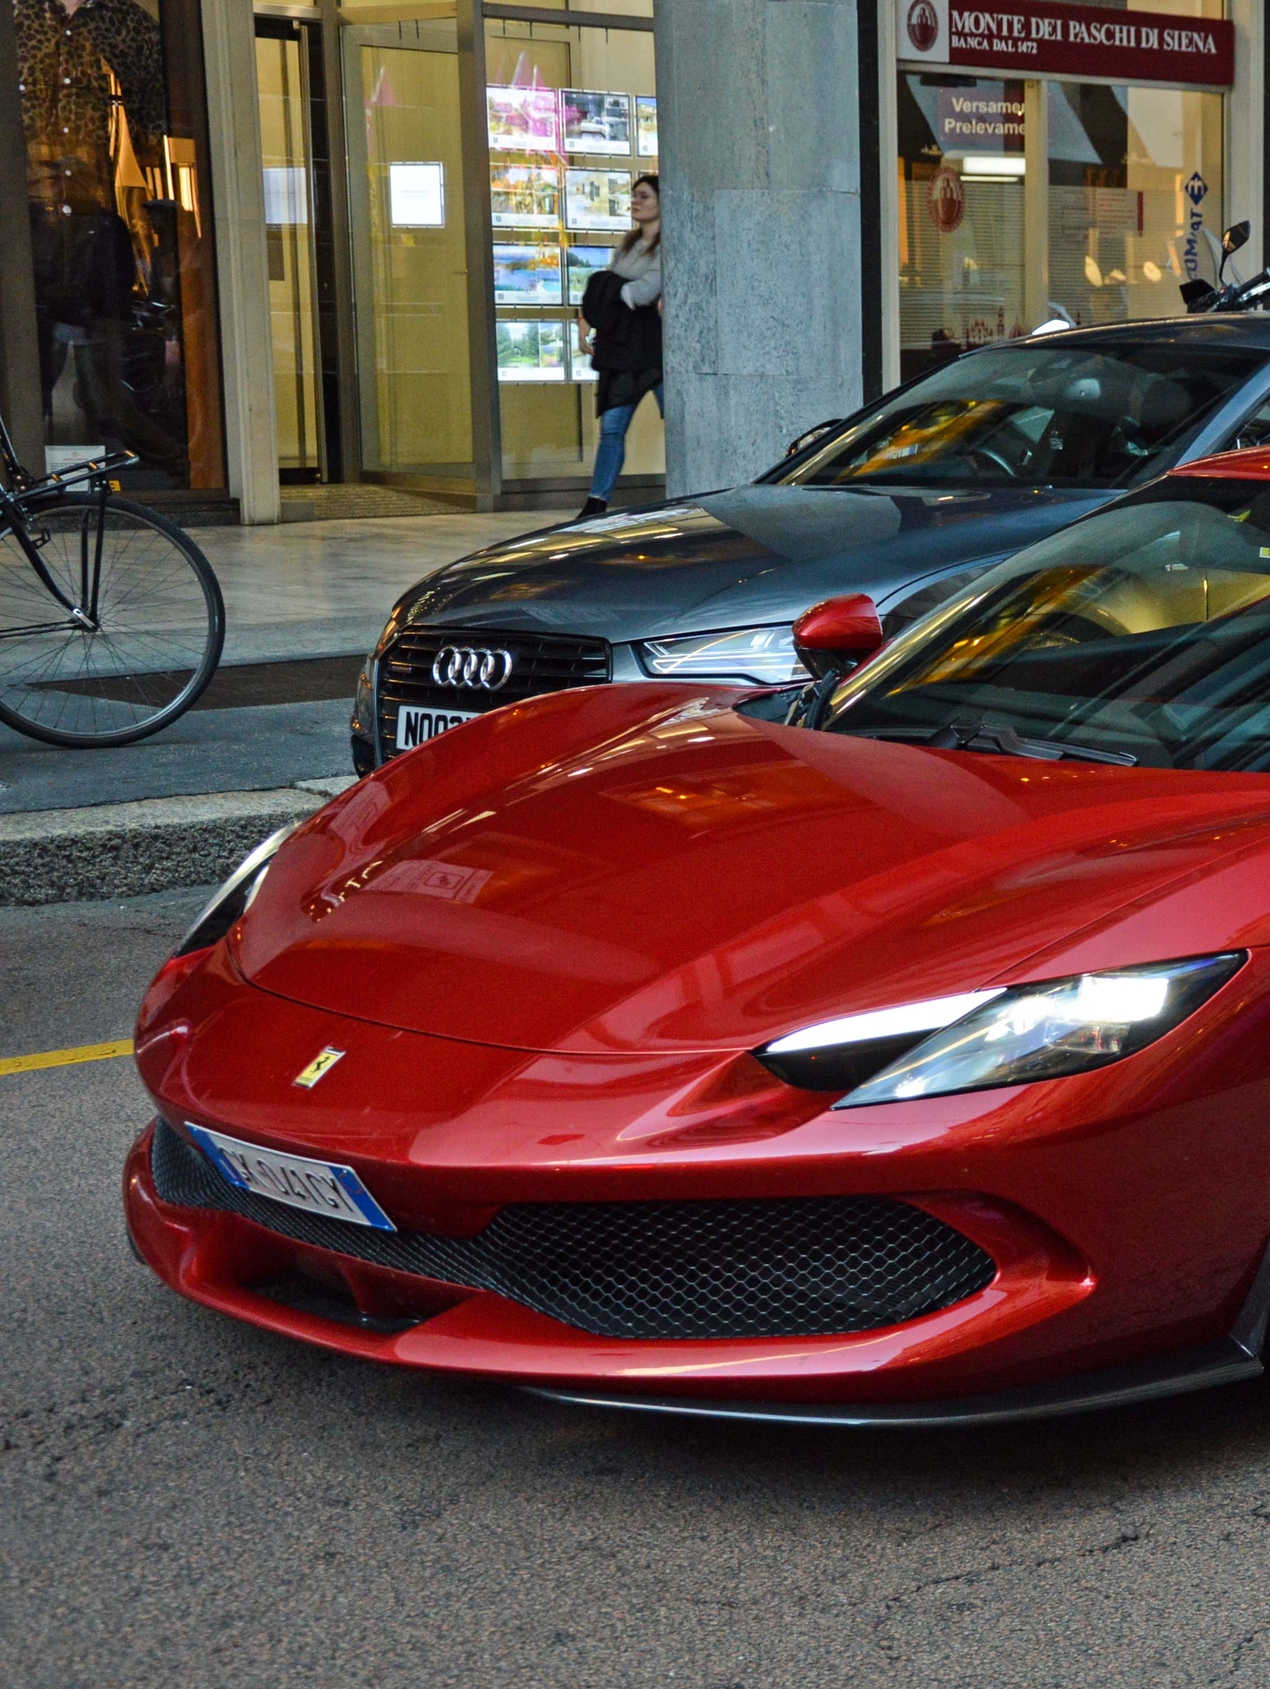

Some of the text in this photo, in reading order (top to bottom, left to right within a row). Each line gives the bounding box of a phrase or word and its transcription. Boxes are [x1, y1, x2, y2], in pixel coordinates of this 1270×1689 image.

[951, 10, 1025, 37] MONTE
[1030, 17, 1062, 41] DEI
[1068, 20, 1136, 47] PASCHI
[1140, 27, 1159, 49] DI
[1164, 29, 1217, 54] SIENA
[951, 35, 1037, 54] BANCA DAL 1472
